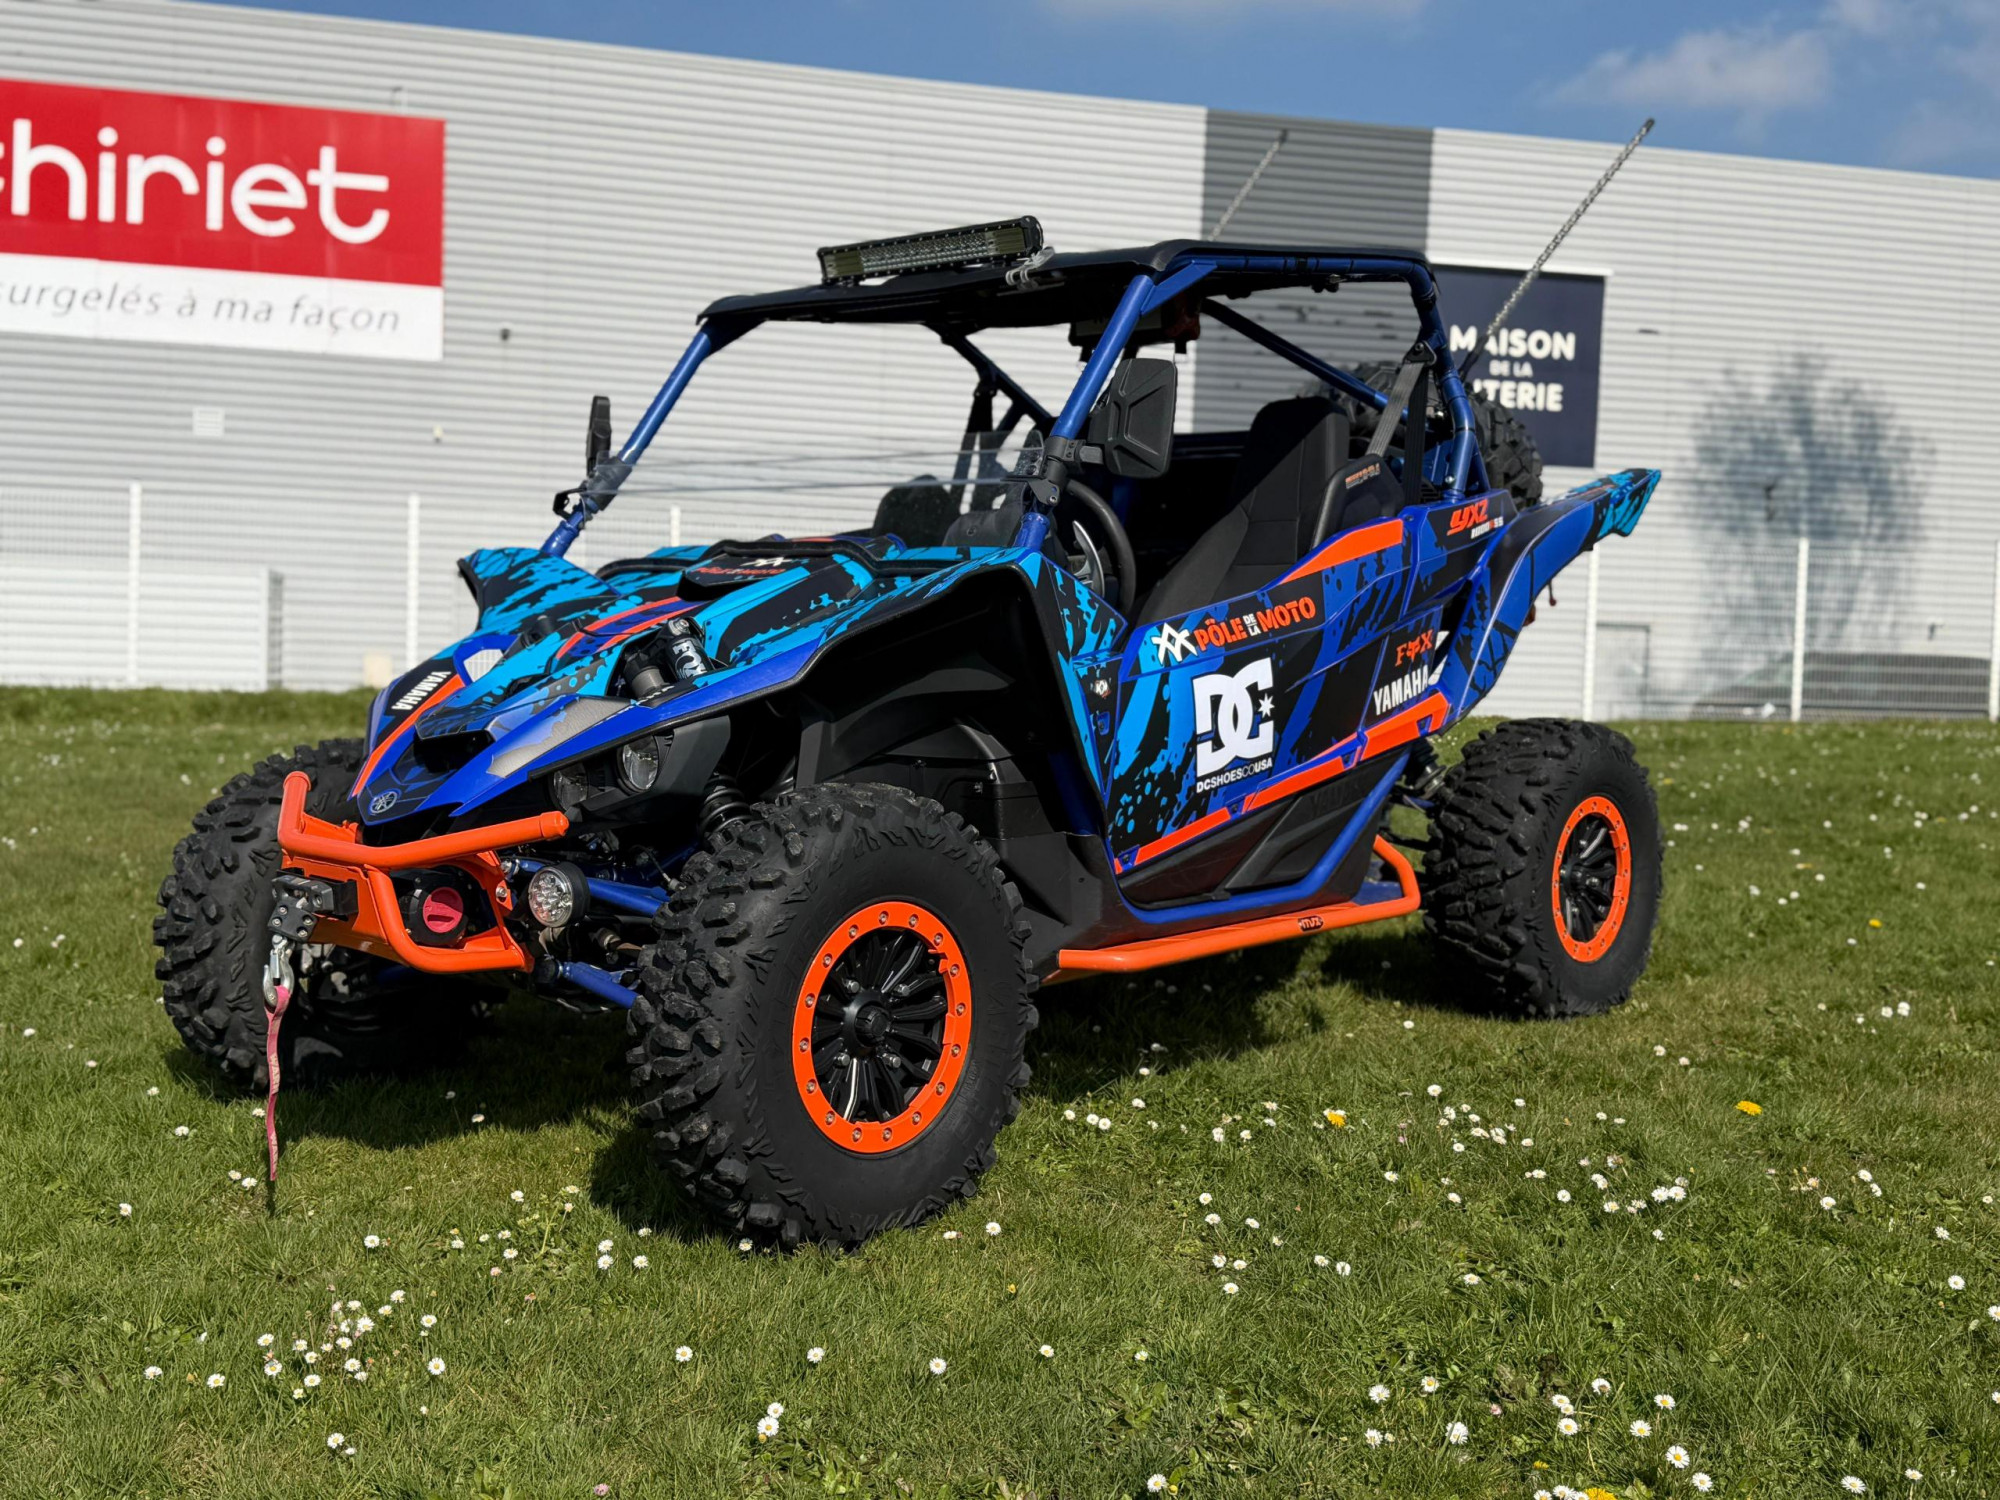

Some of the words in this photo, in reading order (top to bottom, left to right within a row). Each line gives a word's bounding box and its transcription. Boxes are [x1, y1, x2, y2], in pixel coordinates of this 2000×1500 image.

[0, 118, 390, 244] hiriet
[176, 287, 197, 319] à
[213, 295, 274, 324] ma
[288, 294, 400, 338] façon
[1450, 325, 1576, 360] MAISON
[1489, 360, 1510, 377] DE
[1513, 361, 1533, 377] LA
[1243, 613, 1256, 624] DE
[1247, 625, 1261, 636] LA
[1256, 596, 1316, 632] MOTO
[1193, 618, 1248, 651] PÔLE
[1394, 629, 1433, 667] FOX
[391, 671, 452, 710] YAMAHA
[1373, 664, 1429, 716] YAMAHA
[1193, 656, 1275, 778] DC
